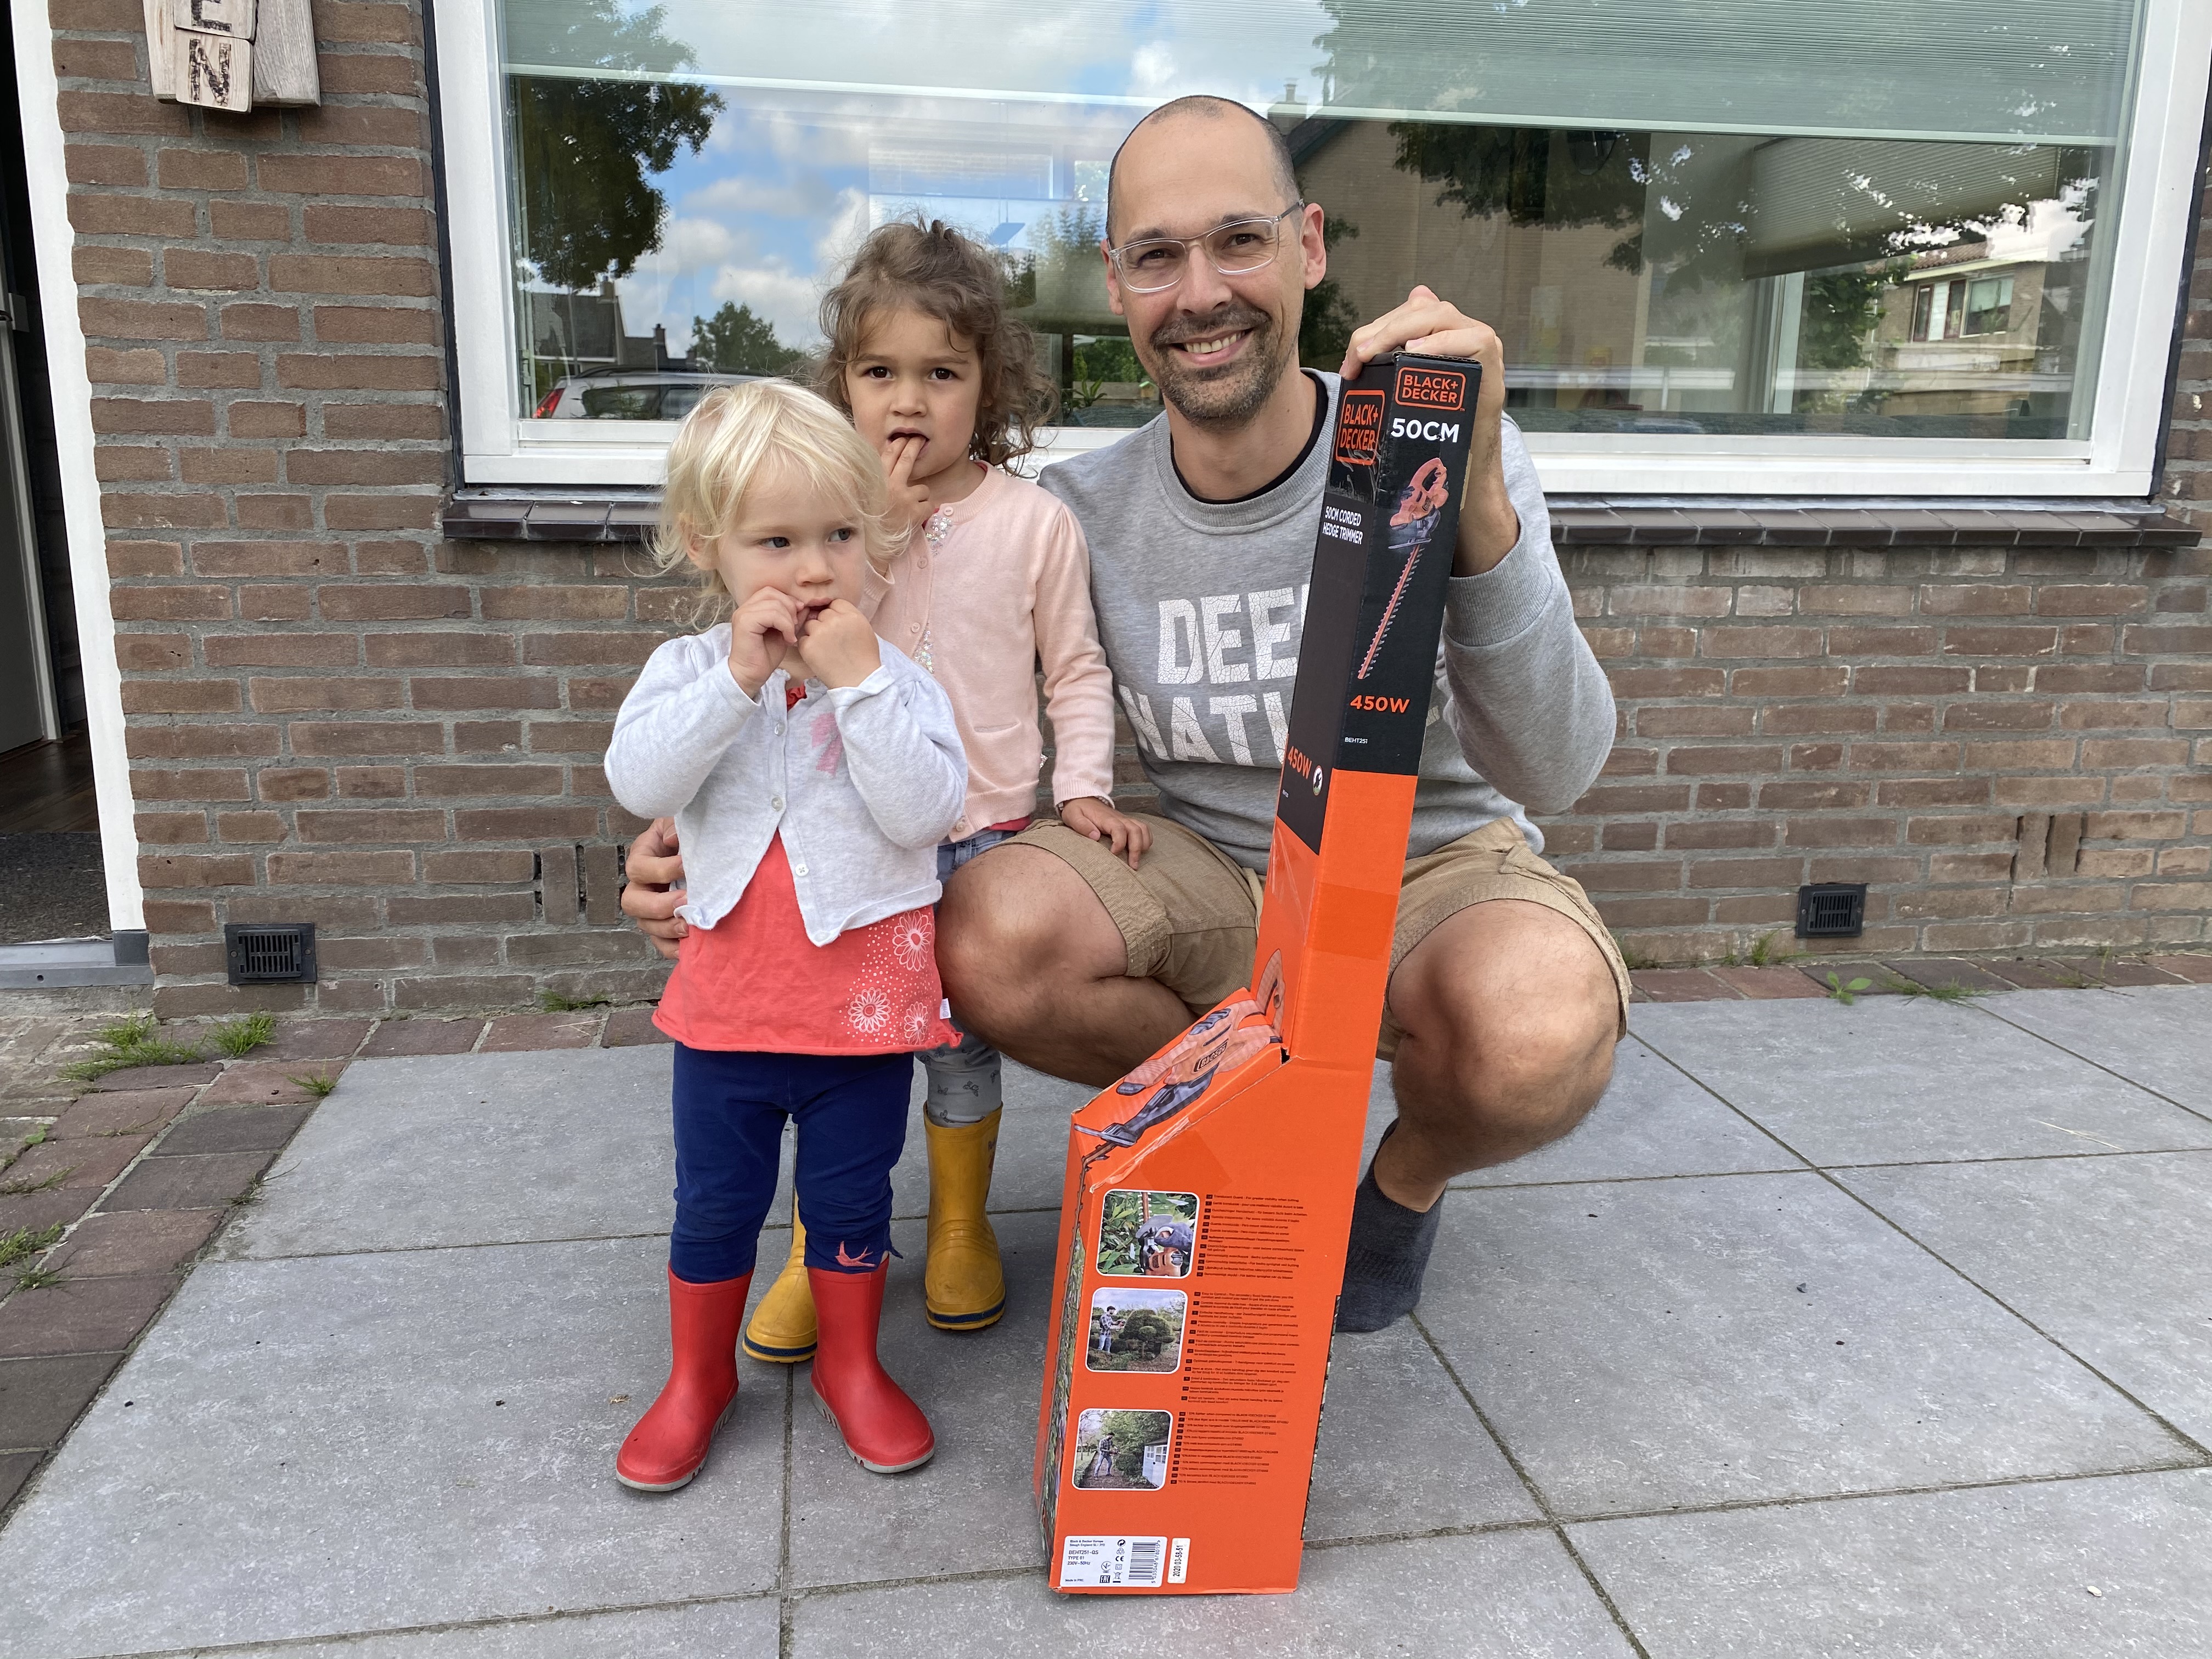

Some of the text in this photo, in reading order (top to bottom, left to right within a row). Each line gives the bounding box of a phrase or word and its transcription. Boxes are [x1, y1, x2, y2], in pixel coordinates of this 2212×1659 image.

[1404, 375, 1458, 390] BLACK+
[1402, 387, 1457, 403] DECKER
[1344, 404, 1378, 426] BLACK+
[1340, 428, 1376, 450] DECKER
[1391, 417, 1459, 442] 50CM
[1325, 506, 1362, 526] 50CM CORDED
[1322, 522, 1363, 544] HEDGE TRIMMER
[1158, 584, 1310, 685] DEE
[1350, 695, 1410, 713] 450W
[1288, 746, 1312, 779] 450W
[1173, 1566, 1181, 1577] 2020
